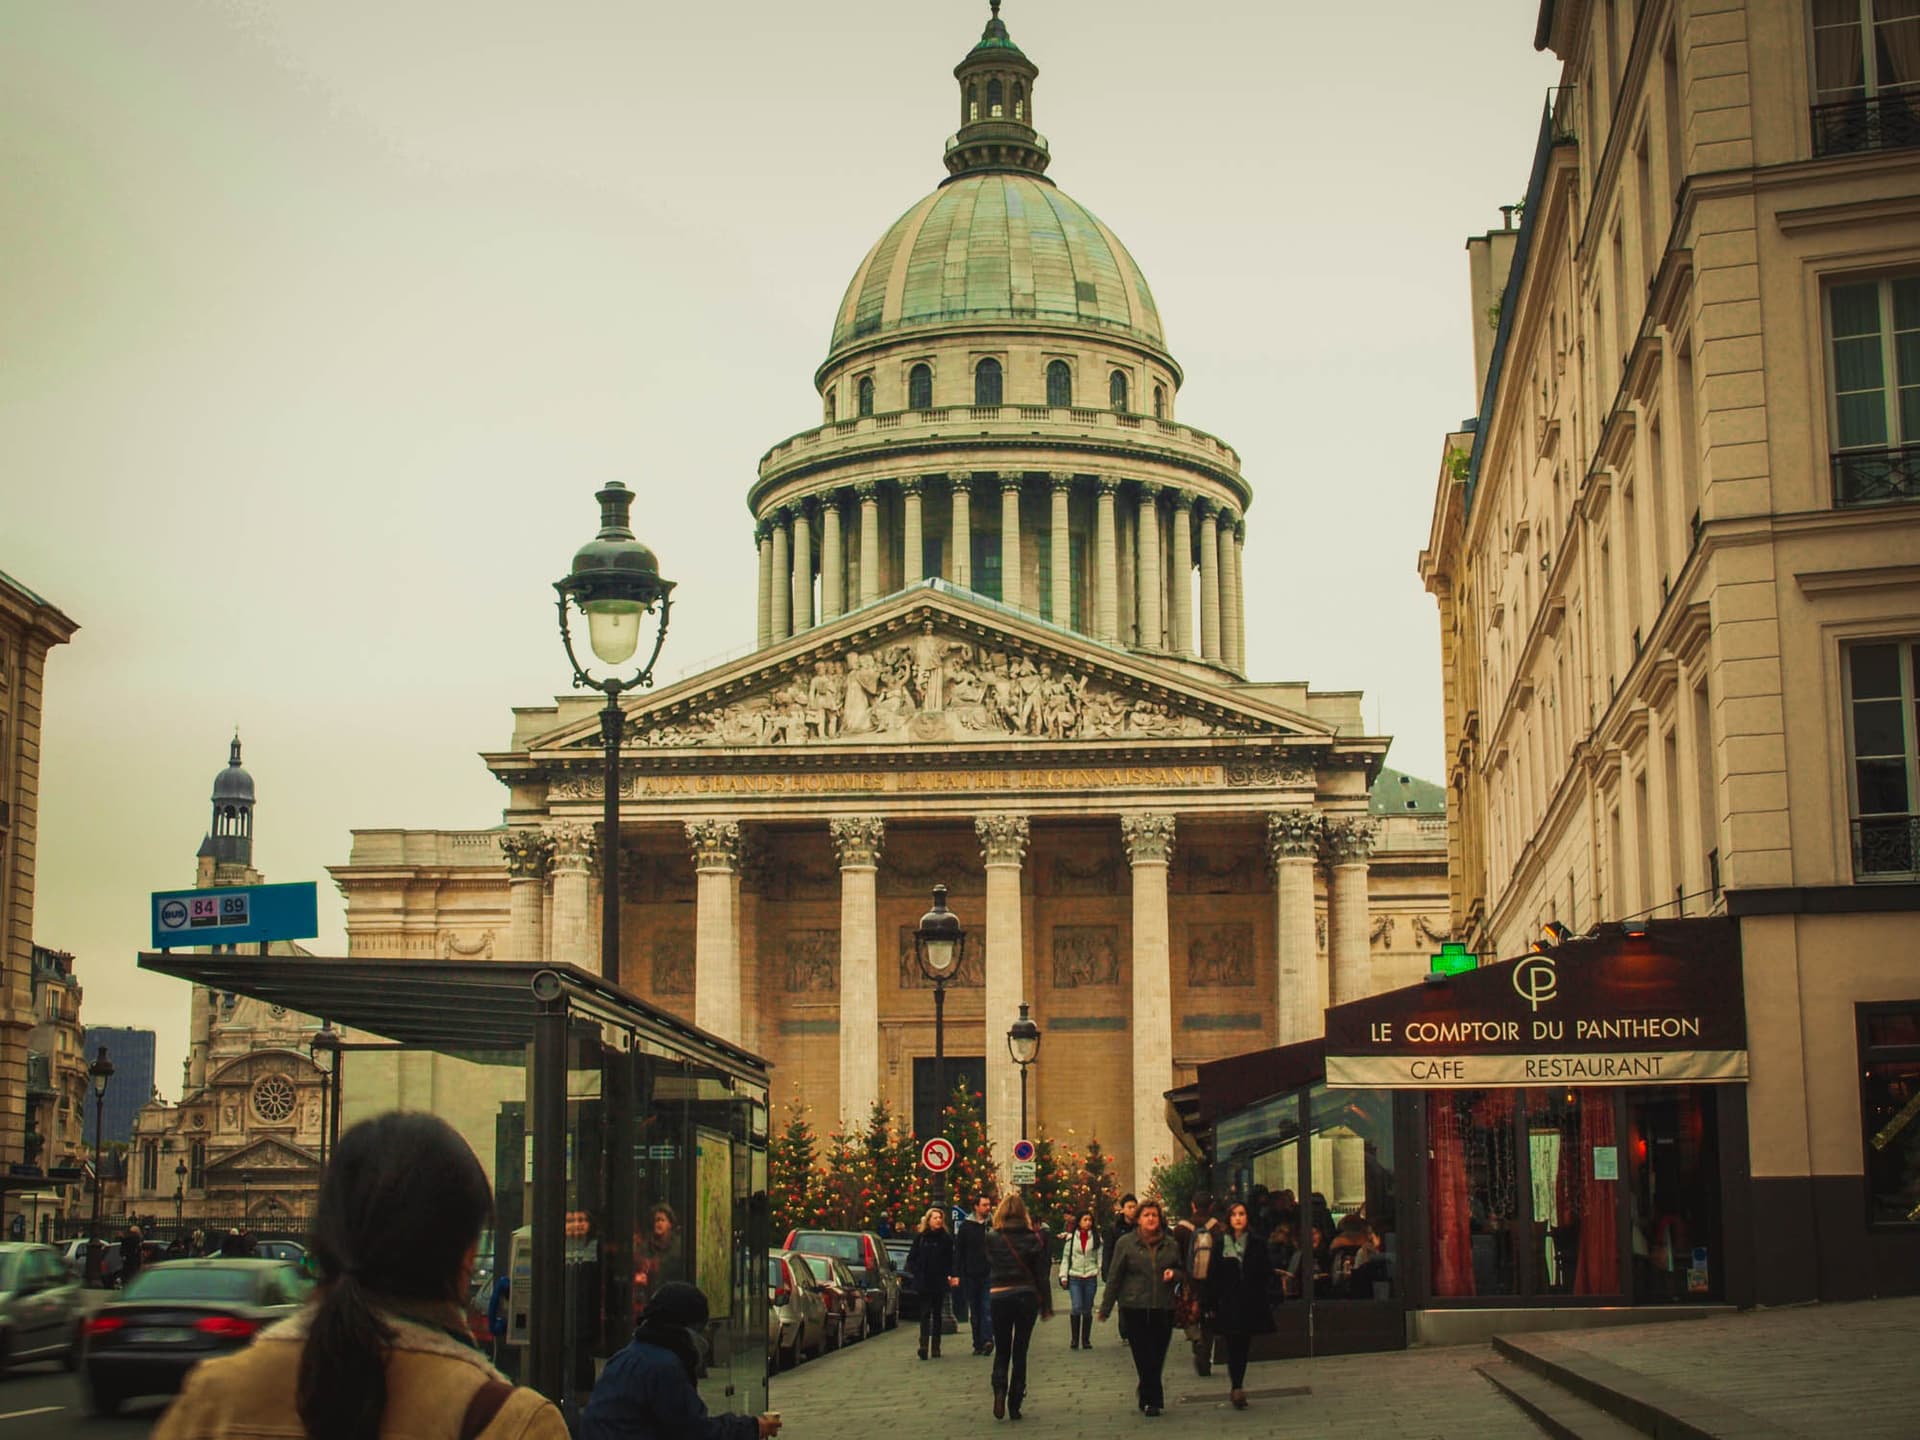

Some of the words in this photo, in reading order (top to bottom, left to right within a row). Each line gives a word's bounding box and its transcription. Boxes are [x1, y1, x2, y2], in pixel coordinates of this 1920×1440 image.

[643, 775, 689, 794] AUX
[695, 774, 785, 793] GRANDS
[791, 772, 884, 792] HOMMES
[897, 771, 927, 791] LA
[931, 770, 1011, 790] PATRIE
[1020, 766, 1216, 788] RECONNAISSANTE
[164, 909, 185, 919] BUS
[194, 900, 214, 914] 84
[224, 898, 244, 913] 89
[1371, 1023, 1393, 1042] LE
[1405, 1021, 1520, 1042] COMPTOIR
[1533, 1020, 1564, 1040] DU
[1576, 1017, 1700, 1040] PANTHEON
[1410, 1061, 1464, 1080] CAFE
[1525, 1057, 1663, 1078] RESTAURANT
